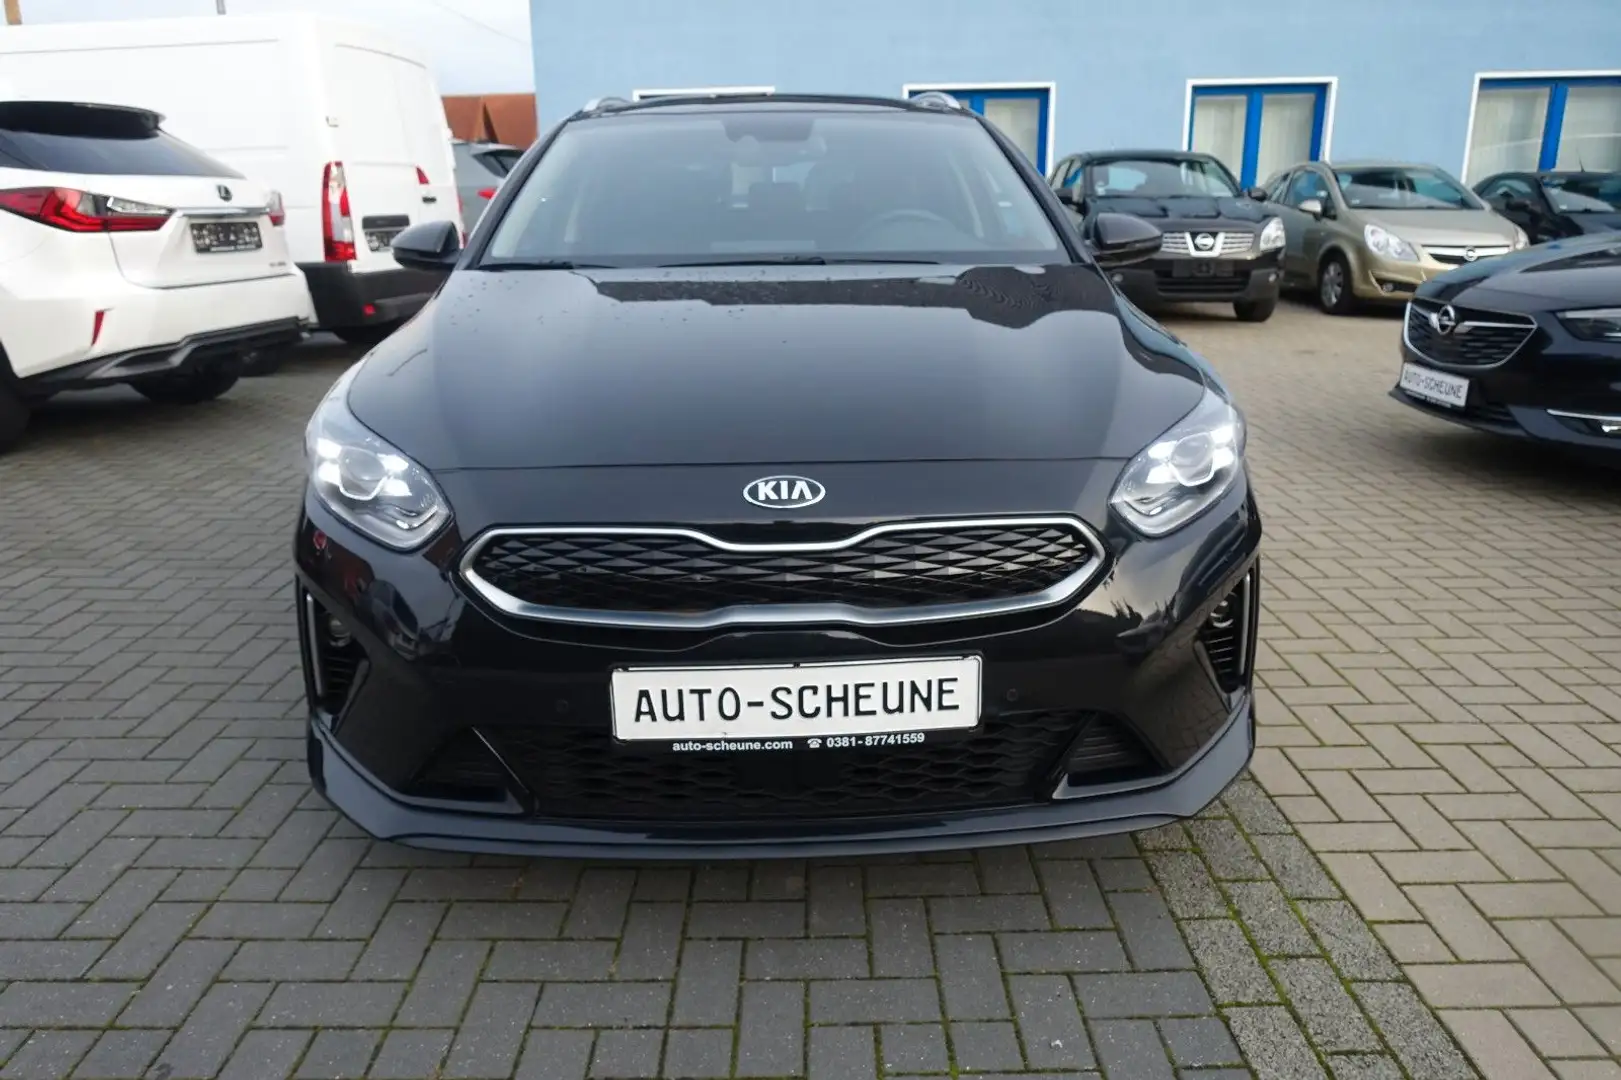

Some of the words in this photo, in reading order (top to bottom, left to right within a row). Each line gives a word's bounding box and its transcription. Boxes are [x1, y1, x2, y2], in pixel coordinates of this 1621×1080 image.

[757, 480, 813, 501] KIA
[634, 677, 960, 723] AUTO-SCHEUNE
[672, 738, 793, 752] auto-scheune.com
